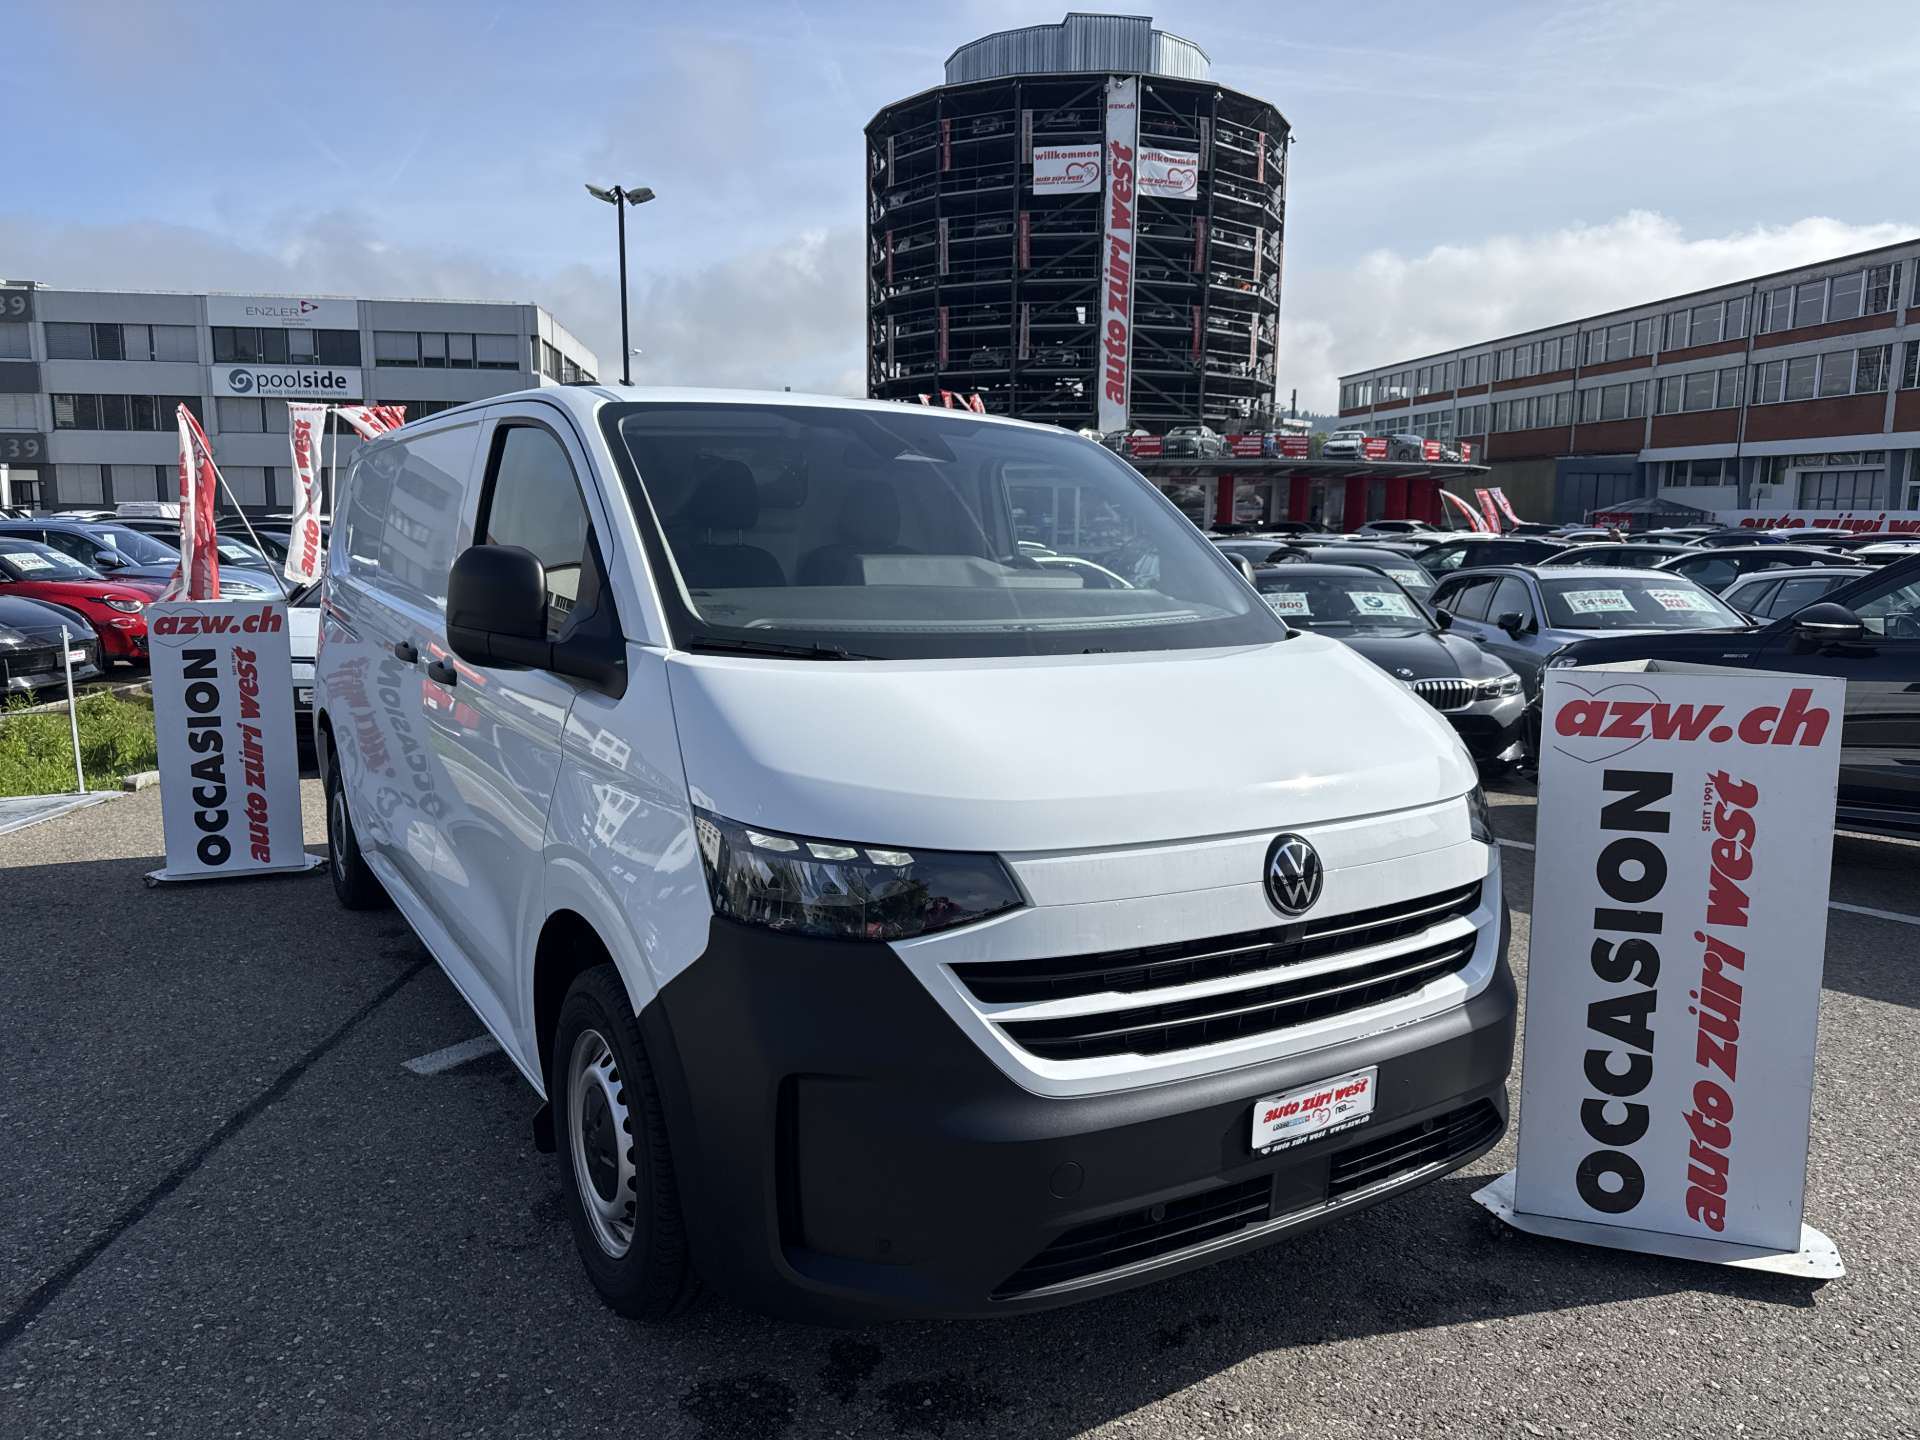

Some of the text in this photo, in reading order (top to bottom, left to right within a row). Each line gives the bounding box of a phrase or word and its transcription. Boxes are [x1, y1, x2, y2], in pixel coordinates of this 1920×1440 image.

[1035, 151, 1099, 161] willkommen
[1140, 152, 1196, 166] willkommen
[1103, 140, 1133, 405] auto züri west
[245, 306, 299, 317] ENZLER
[256, 370, 347, 393] poolside
[8, 439, 39, 458] 39
[295, 418, 312, 469] west
[300, 519, 319, 577] auto
[153, 606, 282, 635] azw.ch
[1554, 688, 1830, 747] azw.ch
[182, 648, 232, 866] OCCASION
[232, 646, 271, 863] auto züri west
[1702, 782, 1714, 832] SEIT 1991
[1575, 768, 1674, 1214] OCCASION
[1681, 769, 1759, 1233] auto züri west
[1263, 1100, 1299, 1124] auto
[1300, 1088, 1334, 1112] züri
[1335, 1078, 1368, 1100] west
